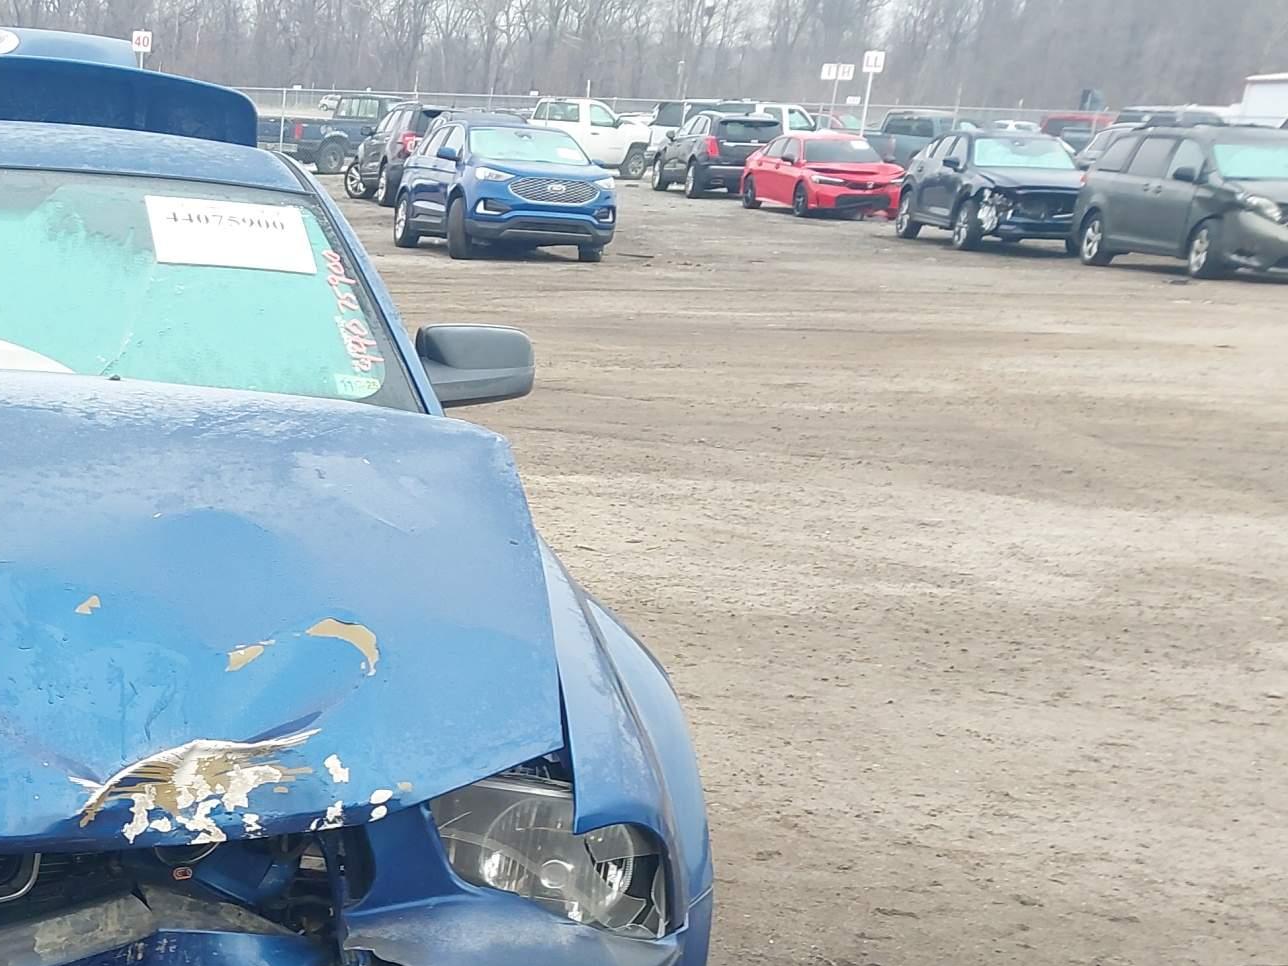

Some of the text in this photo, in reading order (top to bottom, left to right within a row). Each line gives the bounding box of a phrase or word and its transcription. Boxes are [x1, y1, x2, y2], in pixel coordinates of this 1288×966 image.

[134, 35, 150, 48] 40
[865, 55, 882, 68] LL
[166, 212, 285, 231] 44075900
